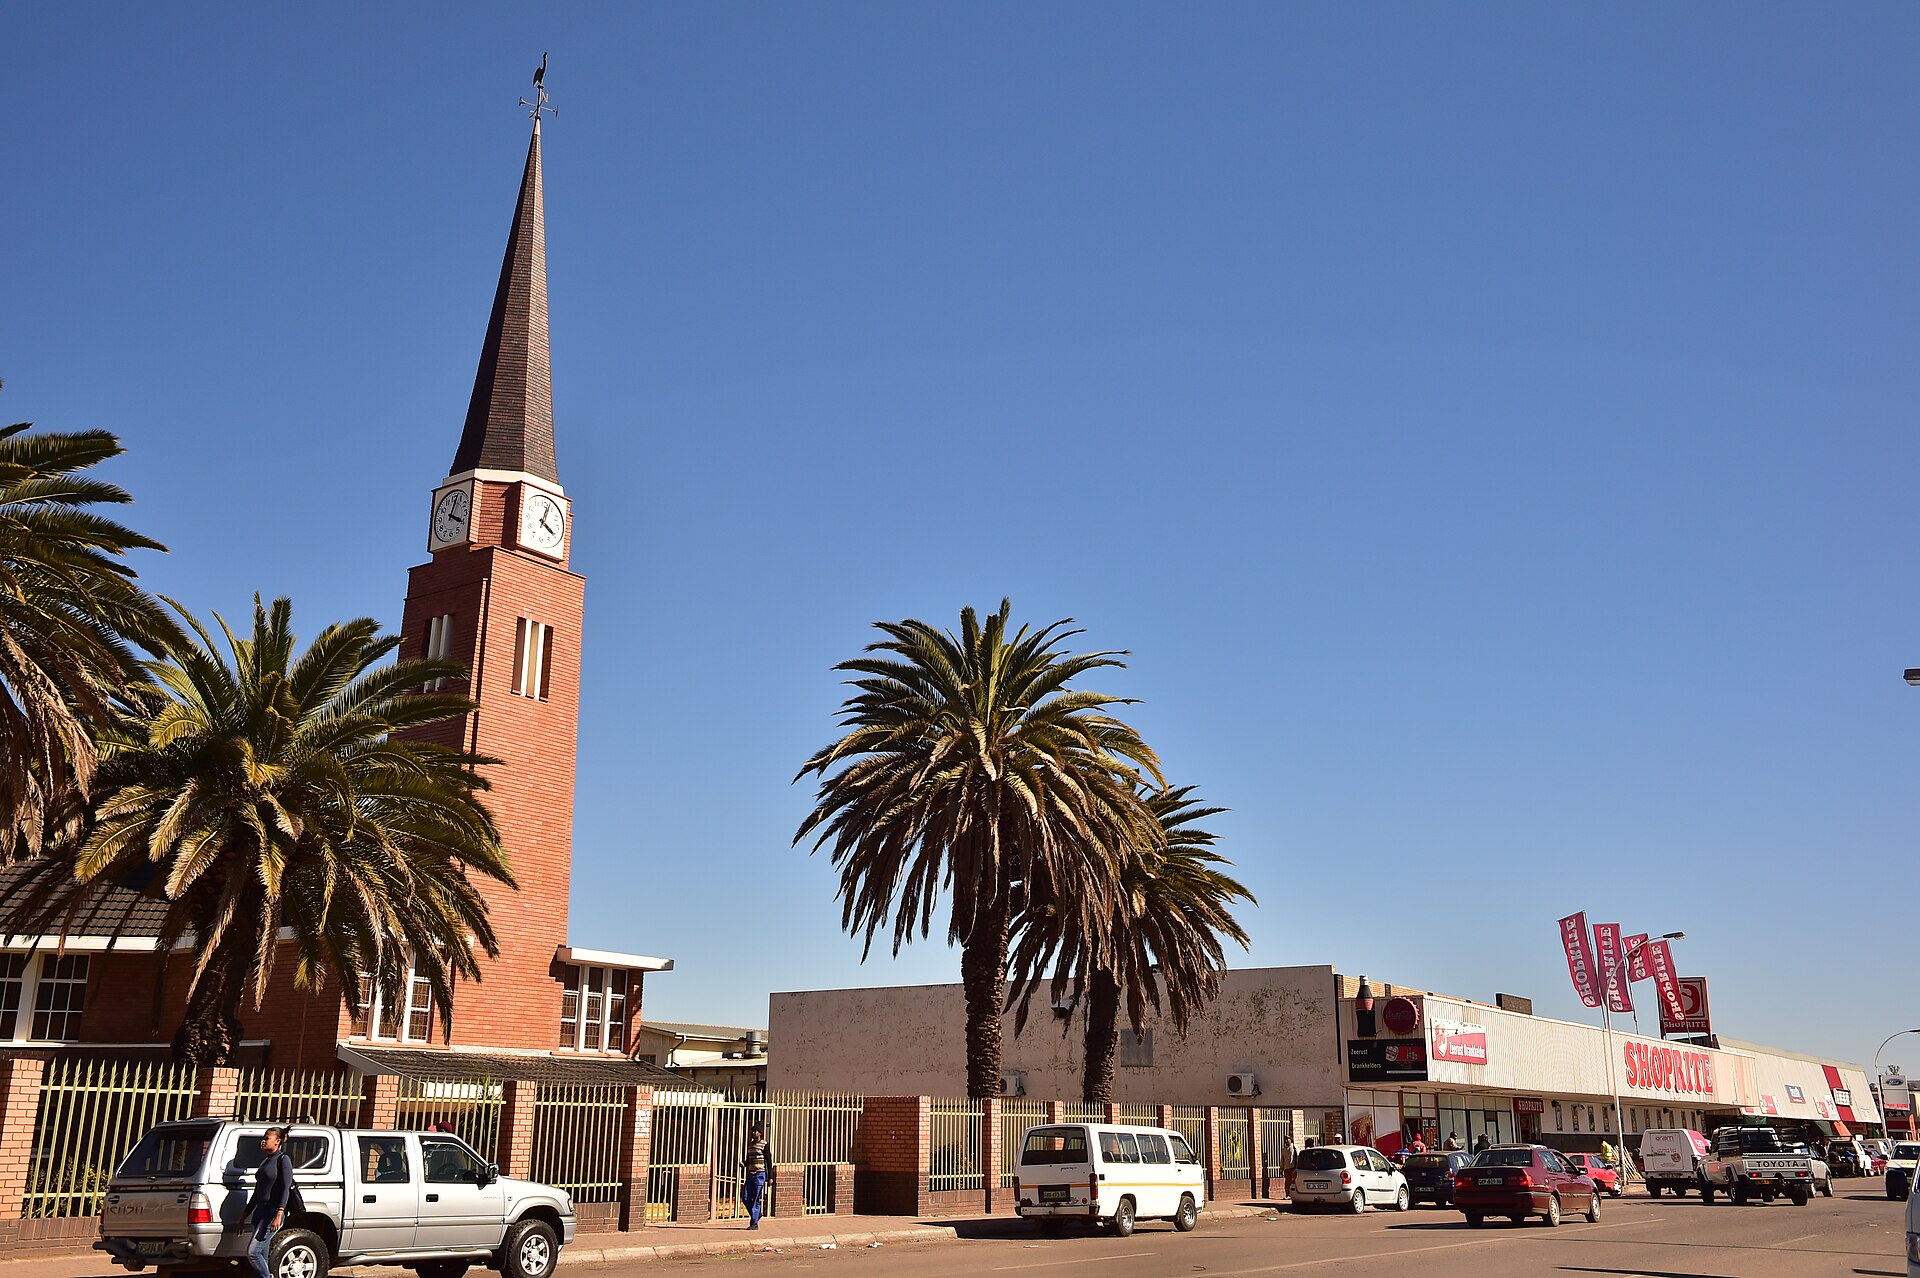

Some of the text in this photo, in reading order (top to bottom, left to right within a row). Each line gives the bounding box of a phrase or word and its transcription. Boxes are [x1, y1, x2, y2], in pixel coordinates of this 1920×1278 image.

[1624, 1040, 1713, 1095] SHOPRITE
[1518, 1100, 1542, 1111] SHOPRITE
[1756, 1160, 1799, 1168] TOYOTA
